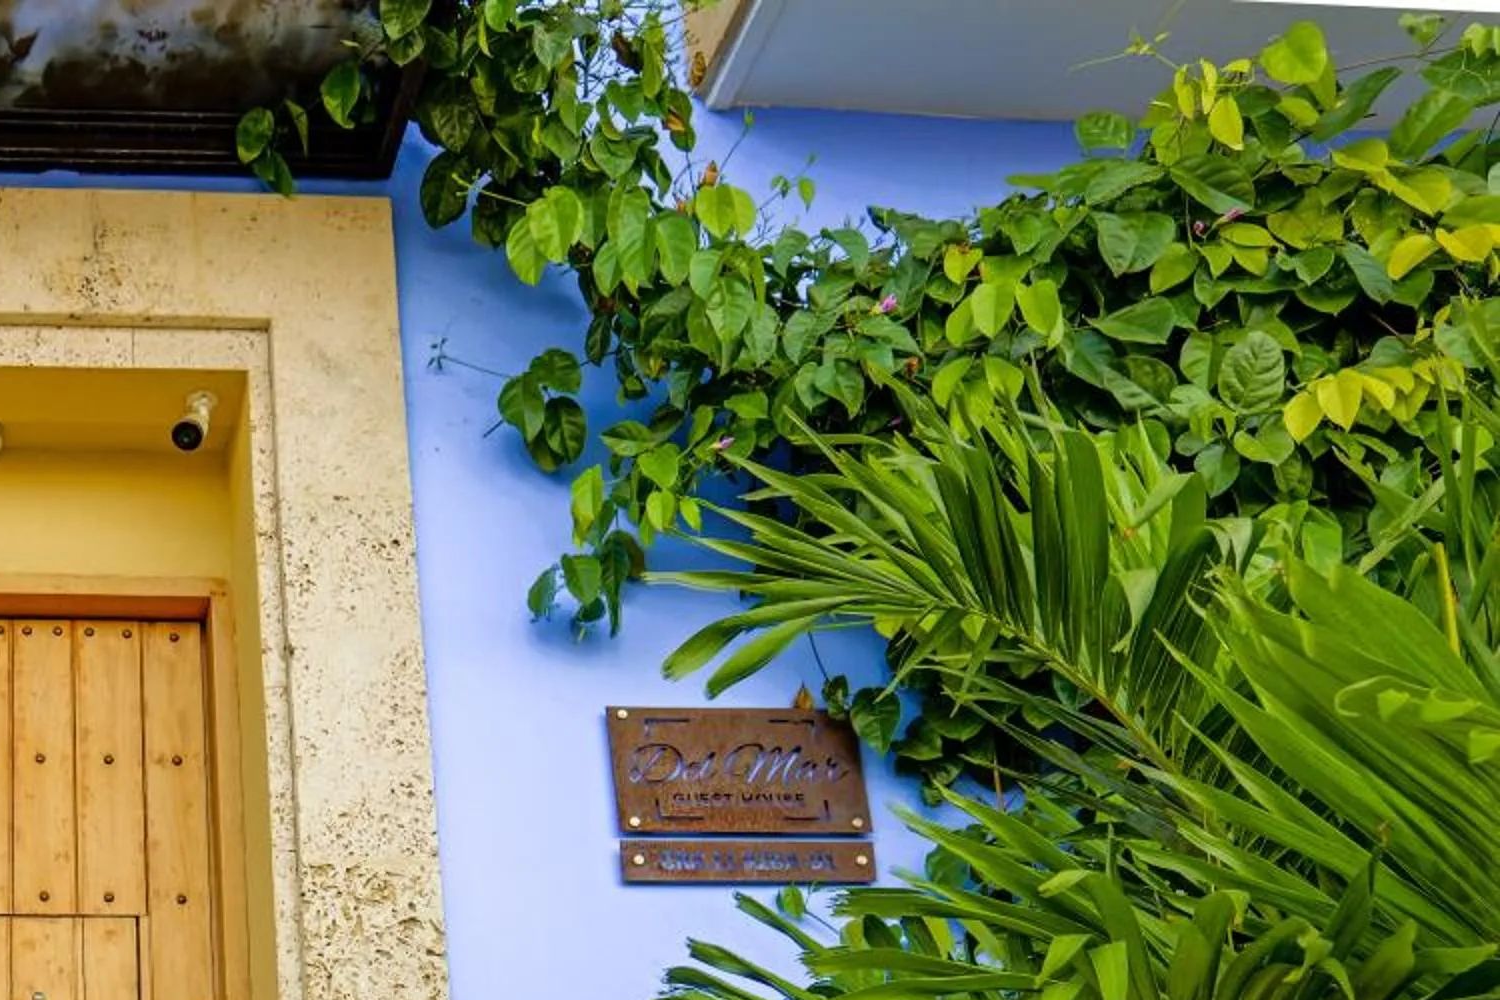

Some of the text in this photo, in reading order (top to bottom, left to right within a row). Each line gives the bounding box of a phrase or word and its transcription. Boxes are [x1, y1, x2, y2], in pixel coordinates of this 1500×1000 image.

[628, 743, 849, 786] Del Mar
[672, 792, 806, 808] GUEST HOUSE
